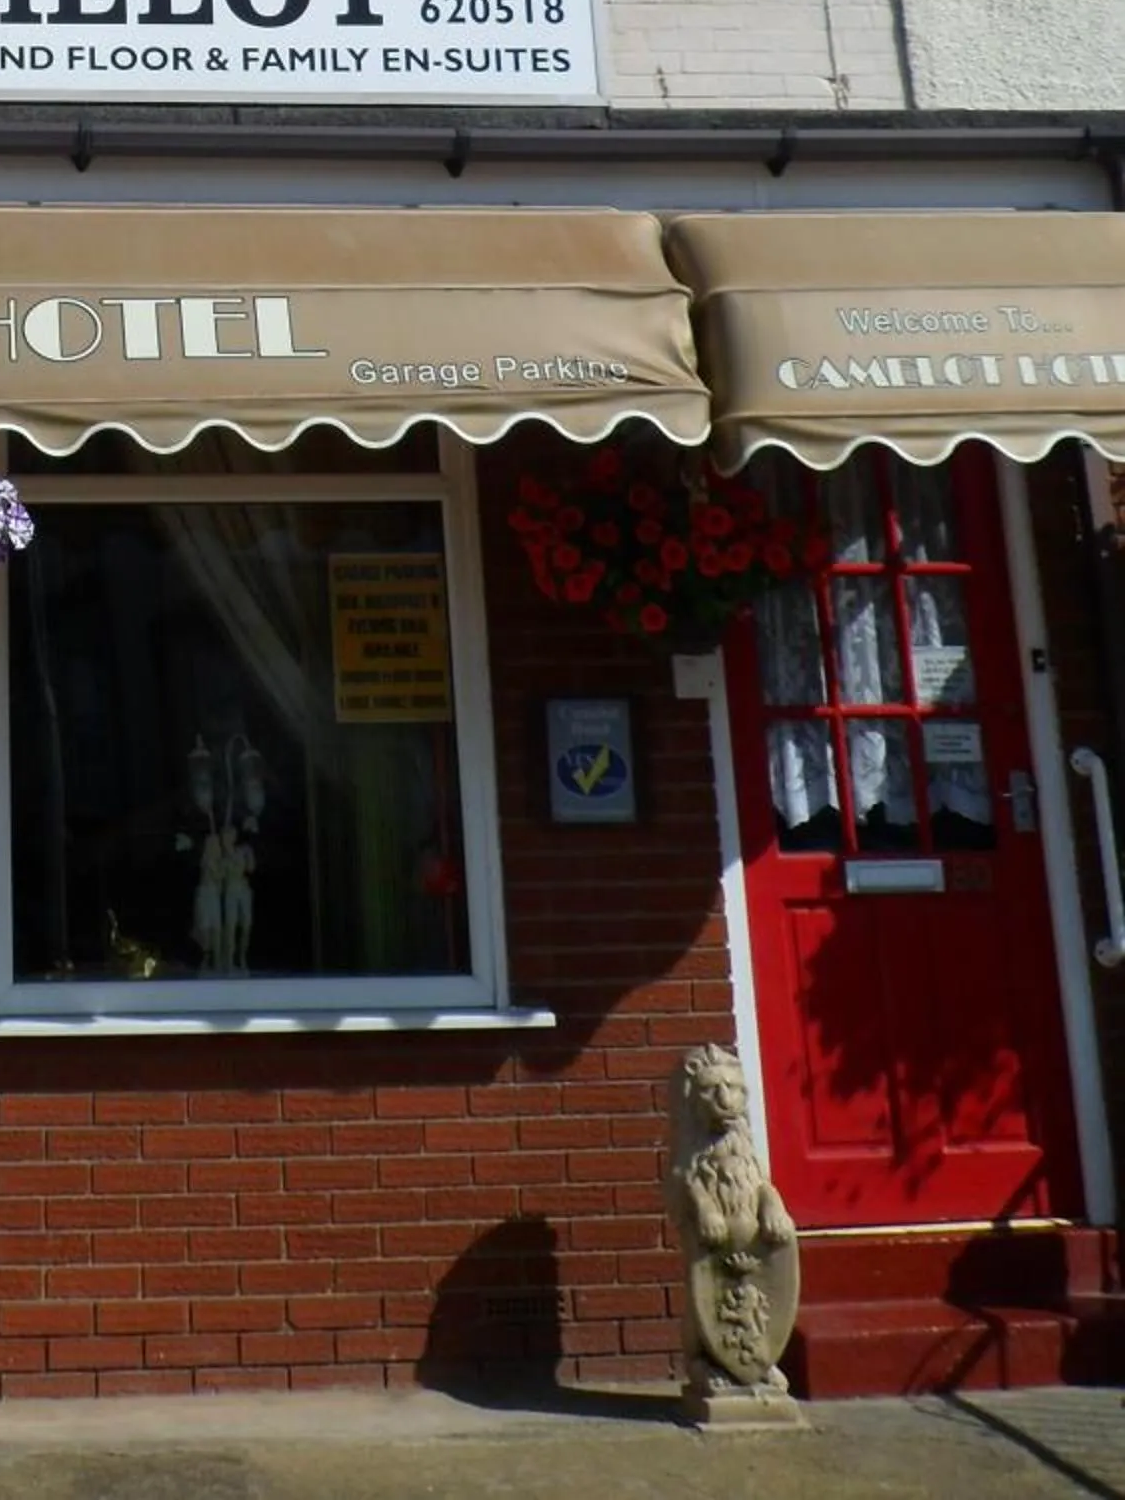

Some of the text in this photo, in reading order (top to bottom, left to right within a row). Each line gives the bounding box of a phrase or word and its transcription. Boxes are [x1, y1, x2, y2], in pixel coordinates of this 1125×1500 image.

[67, 47, 194, 71] FLOOR
[205, 47, 229, 71] &
[242, 47, 369, 71] FAMILY
[382, 48, 571, 73] EN-SUITES
[835, 306, 990, 335] Welcome
[350, 356, 630, 387] Garage Parking
[777, 354, 1003, 389] CAMELOT
